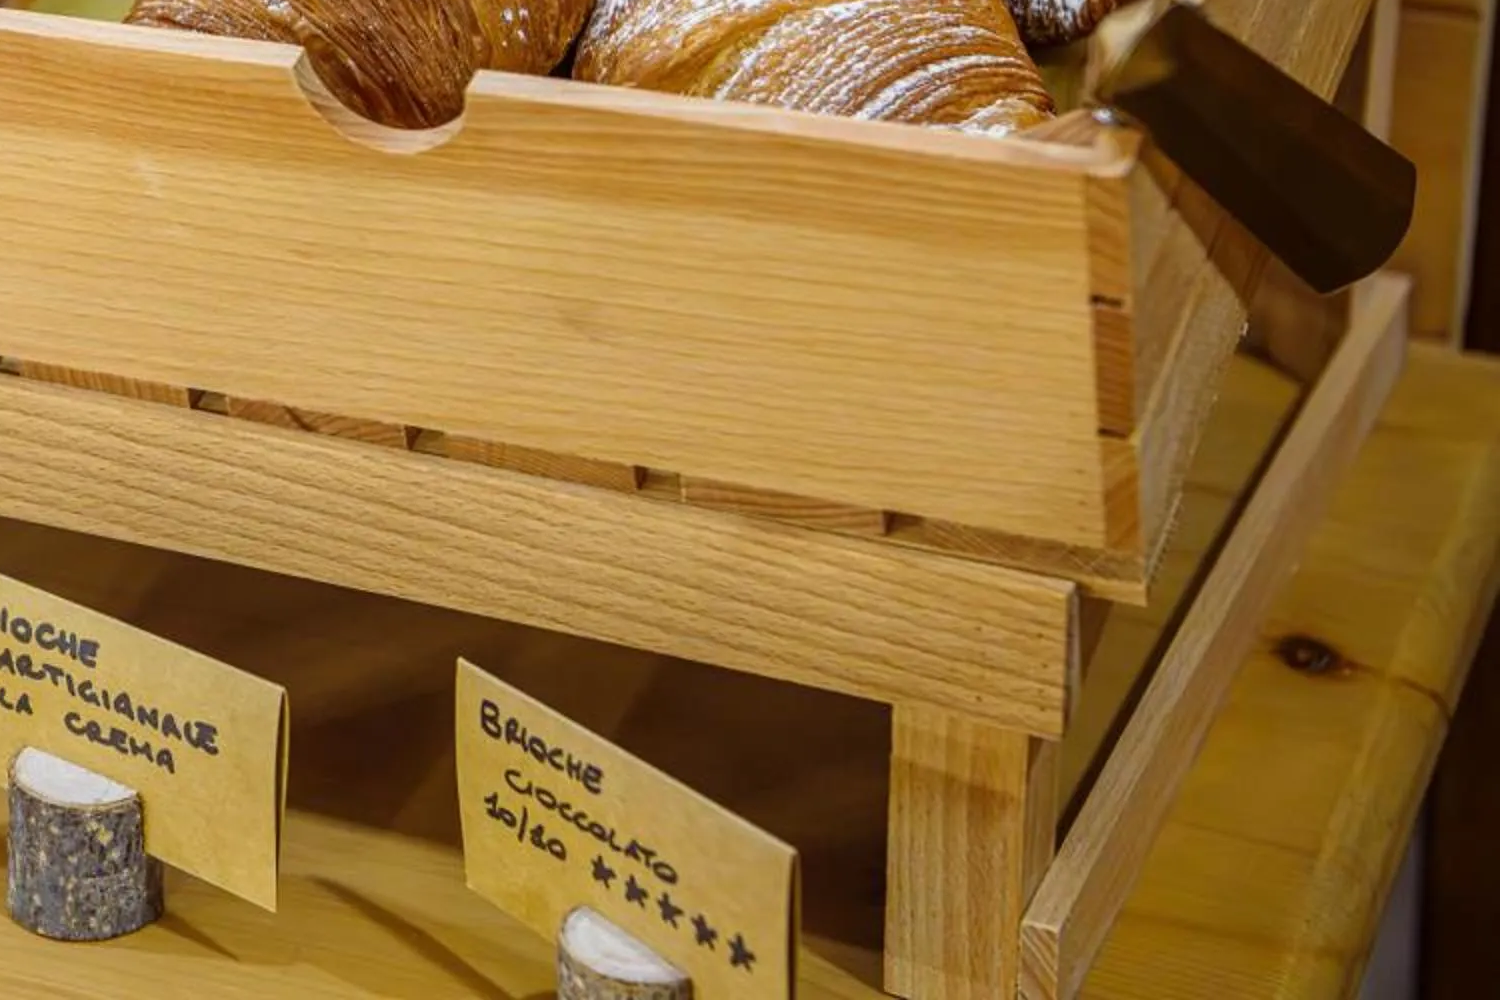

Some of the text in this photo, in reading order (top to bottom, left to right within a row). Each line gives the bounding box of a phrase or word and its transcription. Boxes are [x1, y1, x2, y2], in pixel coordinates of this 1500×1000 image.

[64, 711, 176, 774] CREMA
[480, 699, 605, 796] BRIOCHE
[504, 769, 678, 885] CIOCCOLATO
